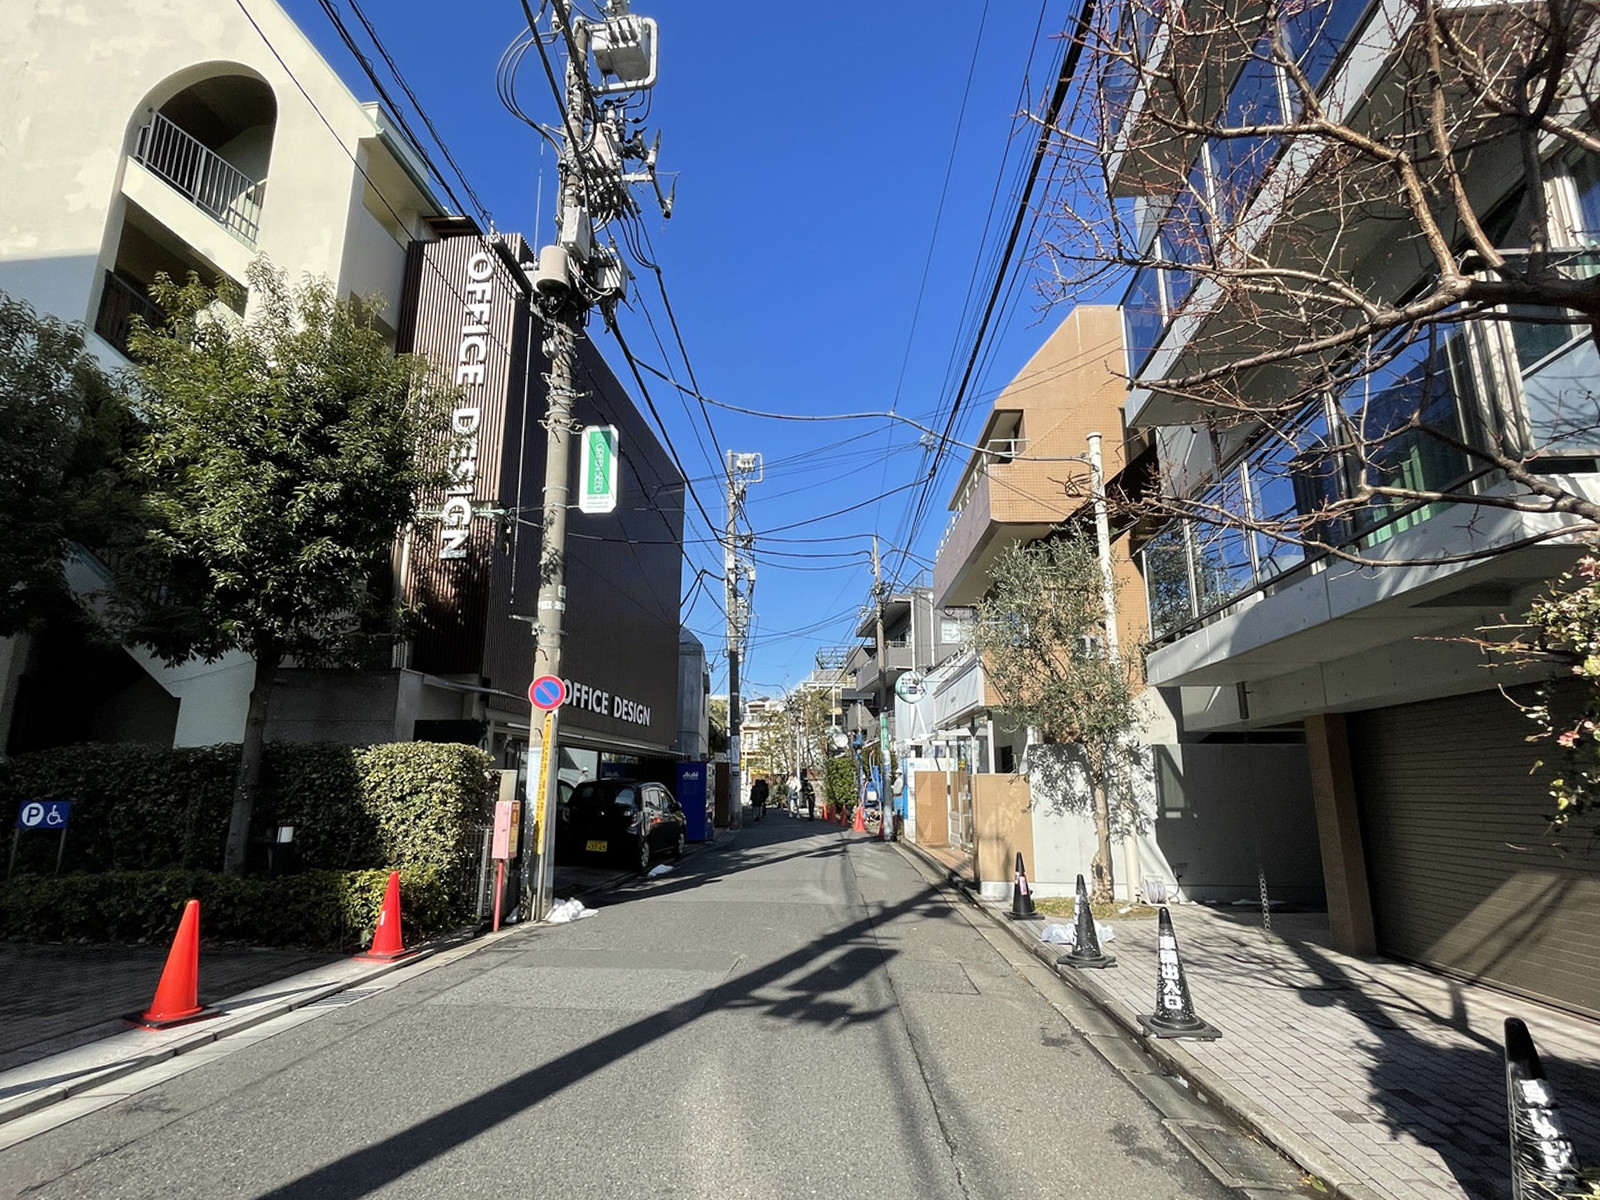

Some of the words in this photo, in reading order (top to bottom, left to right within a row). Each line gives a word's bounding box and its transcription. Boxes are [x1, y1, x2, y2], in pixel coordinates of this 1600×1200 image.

[457, 251, 495, 385] OFFICE
[439, 408, 481, 558] DESIGN
[563, 678, 610, 715] OFFICE
[613, 695, 651, 726] DESIGN
[26, 806, 41, 824] P
